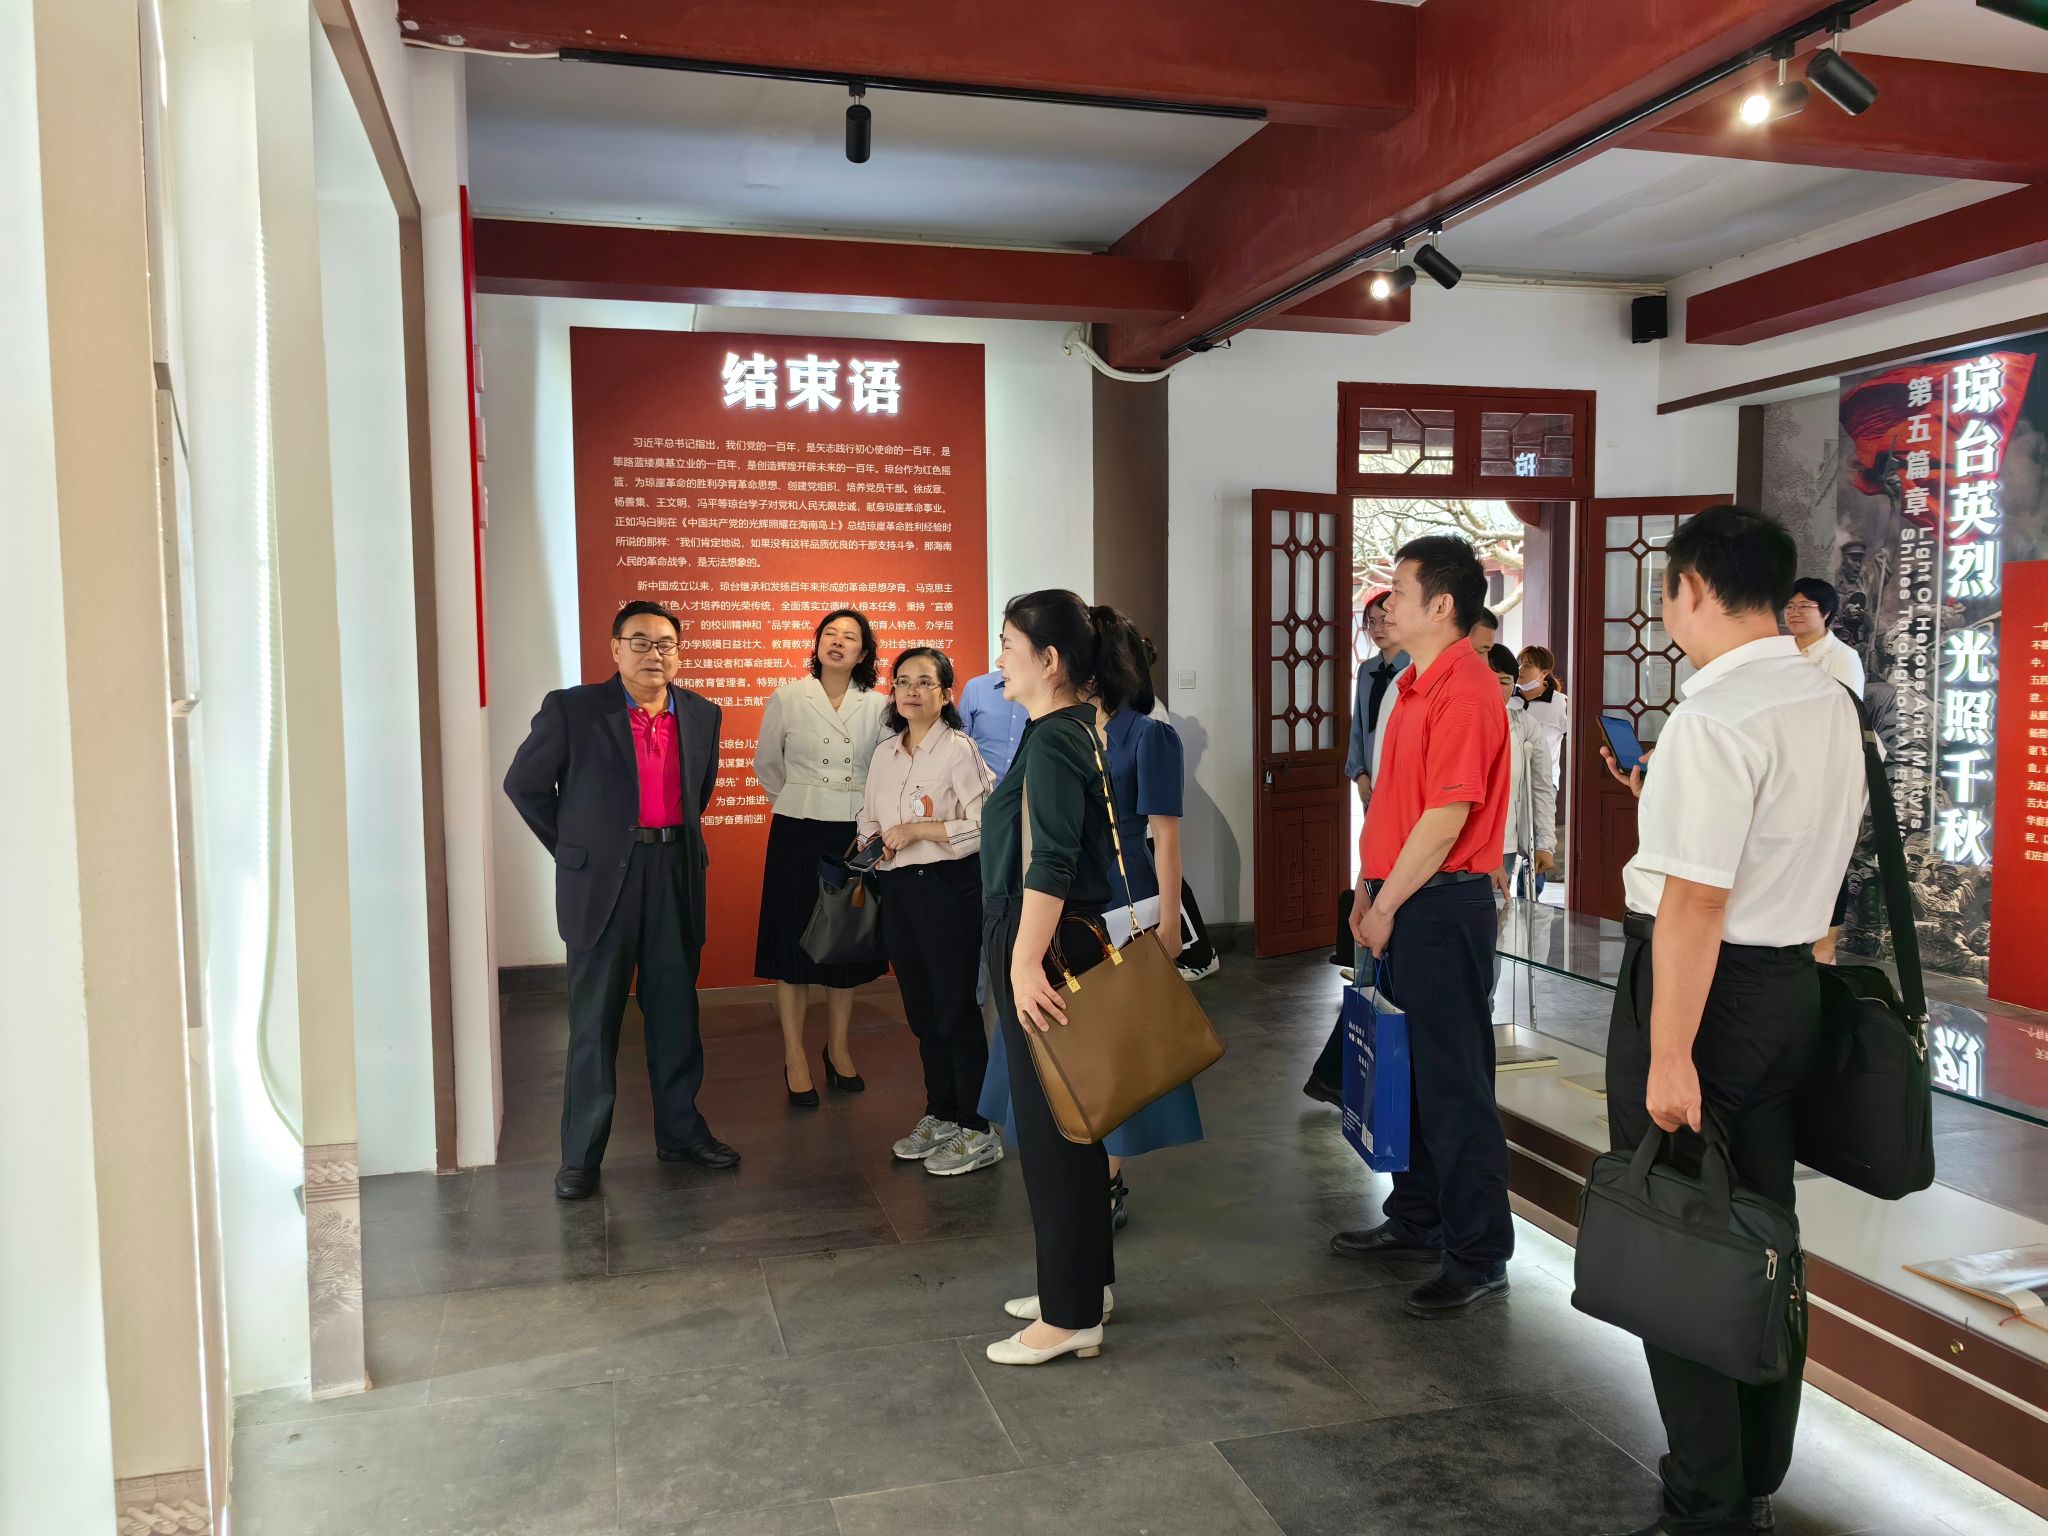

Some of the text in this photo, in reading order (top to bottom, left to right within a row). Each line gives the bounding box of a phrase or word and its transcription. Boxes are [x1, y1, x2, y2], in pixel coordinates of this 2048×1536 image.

[720, 351, 902, 416] 结束语
[1904, 376, 1933, 516] 第五篇章
[616, 554, 763, 569] 人民的革命战争，是无法想象的。
[1899, 527, 1917, 601] Shines
[1937, 355, 2004, 866] 琼台英烈 光照千秋
[1893, 605, 1914, 732] Throughout
[1908, 526, 1934, 831] Light Of Heroes And Martyrs
[1894, 734, 1909, 763] All
